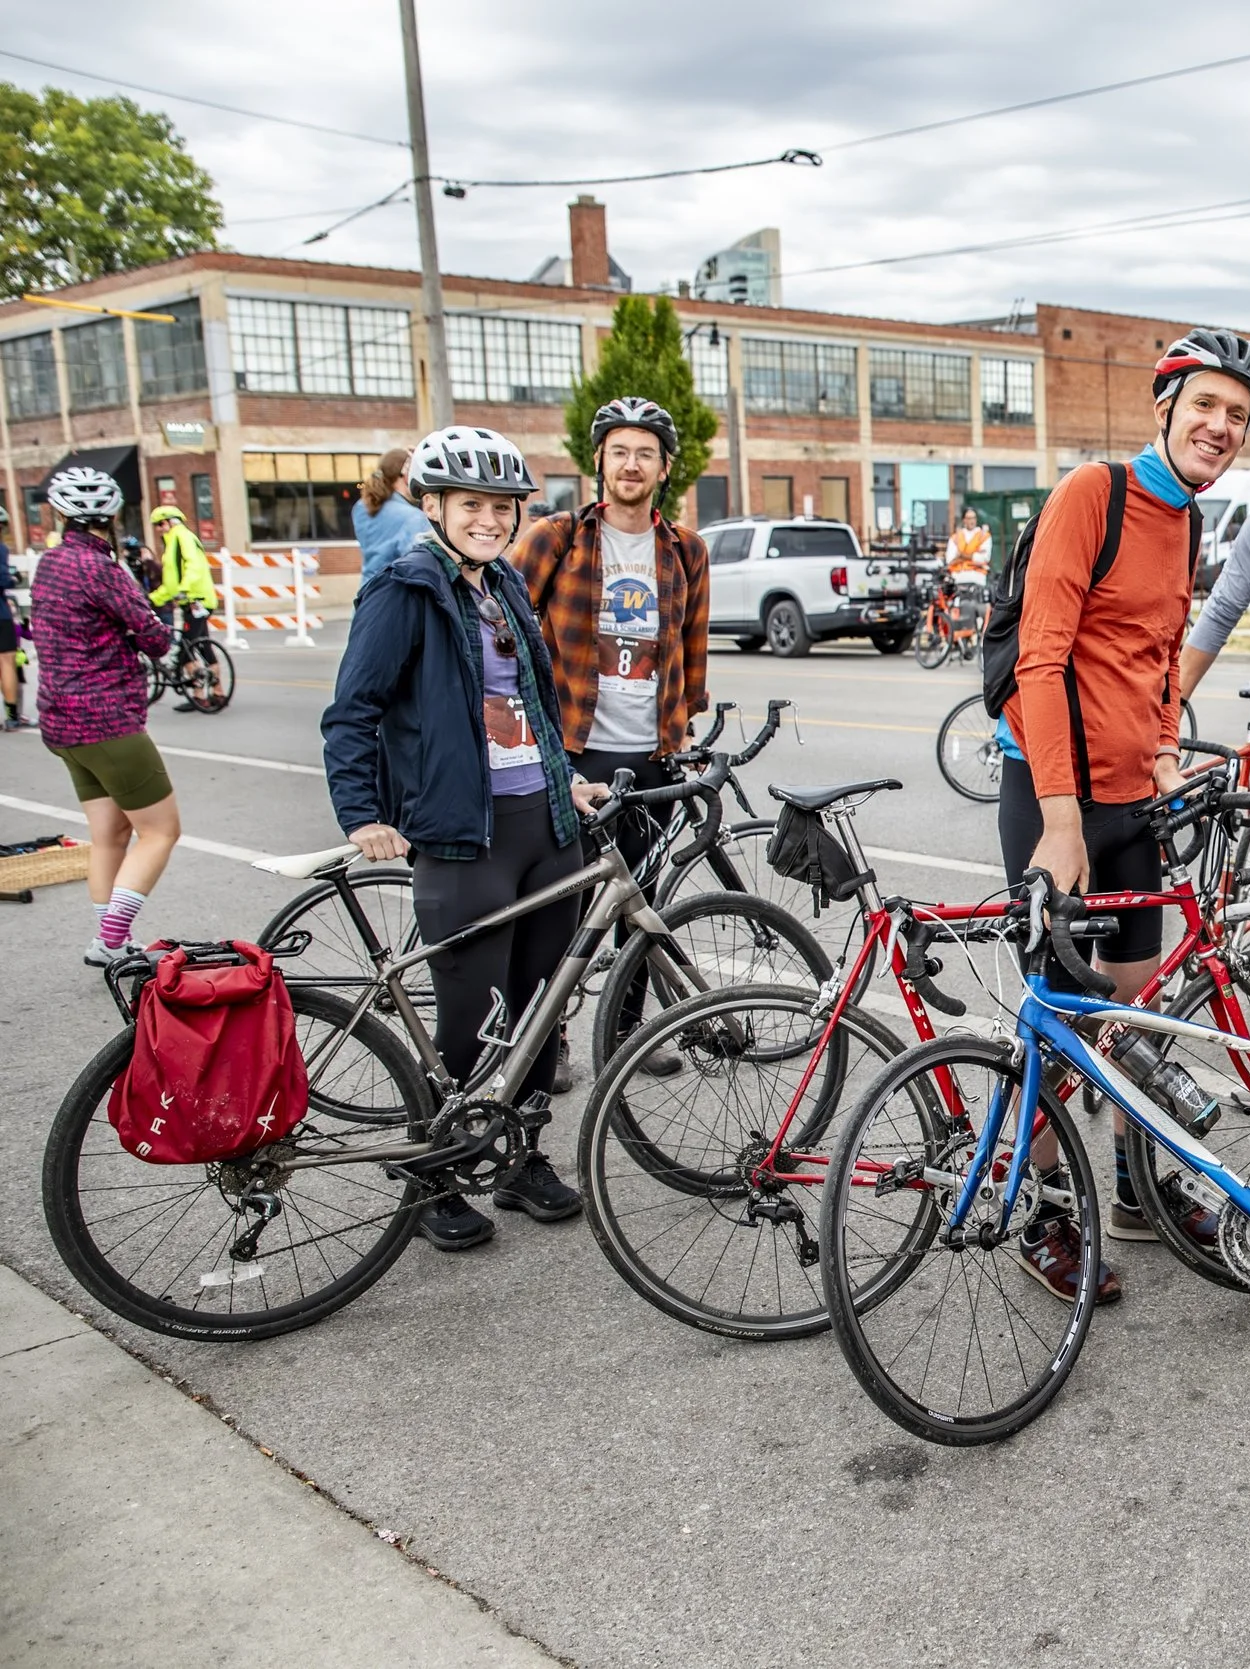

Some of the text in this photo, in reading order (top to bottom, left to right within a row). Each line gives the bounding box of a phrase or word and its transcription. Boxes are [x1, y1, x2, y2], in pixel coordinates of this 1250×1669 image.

[623, 589, 649, 610] W
[618, 649, 632, 676] 8
[513, 709, 527, 743] 7
[557, 872, 601, 896] cannondale
[1081, 996, 1123, 1007] DOLCE
[1156, 1216, 1199, 1264] CONTINENTAL
[696, 1321, 764, 1339] CONTINENTAL
